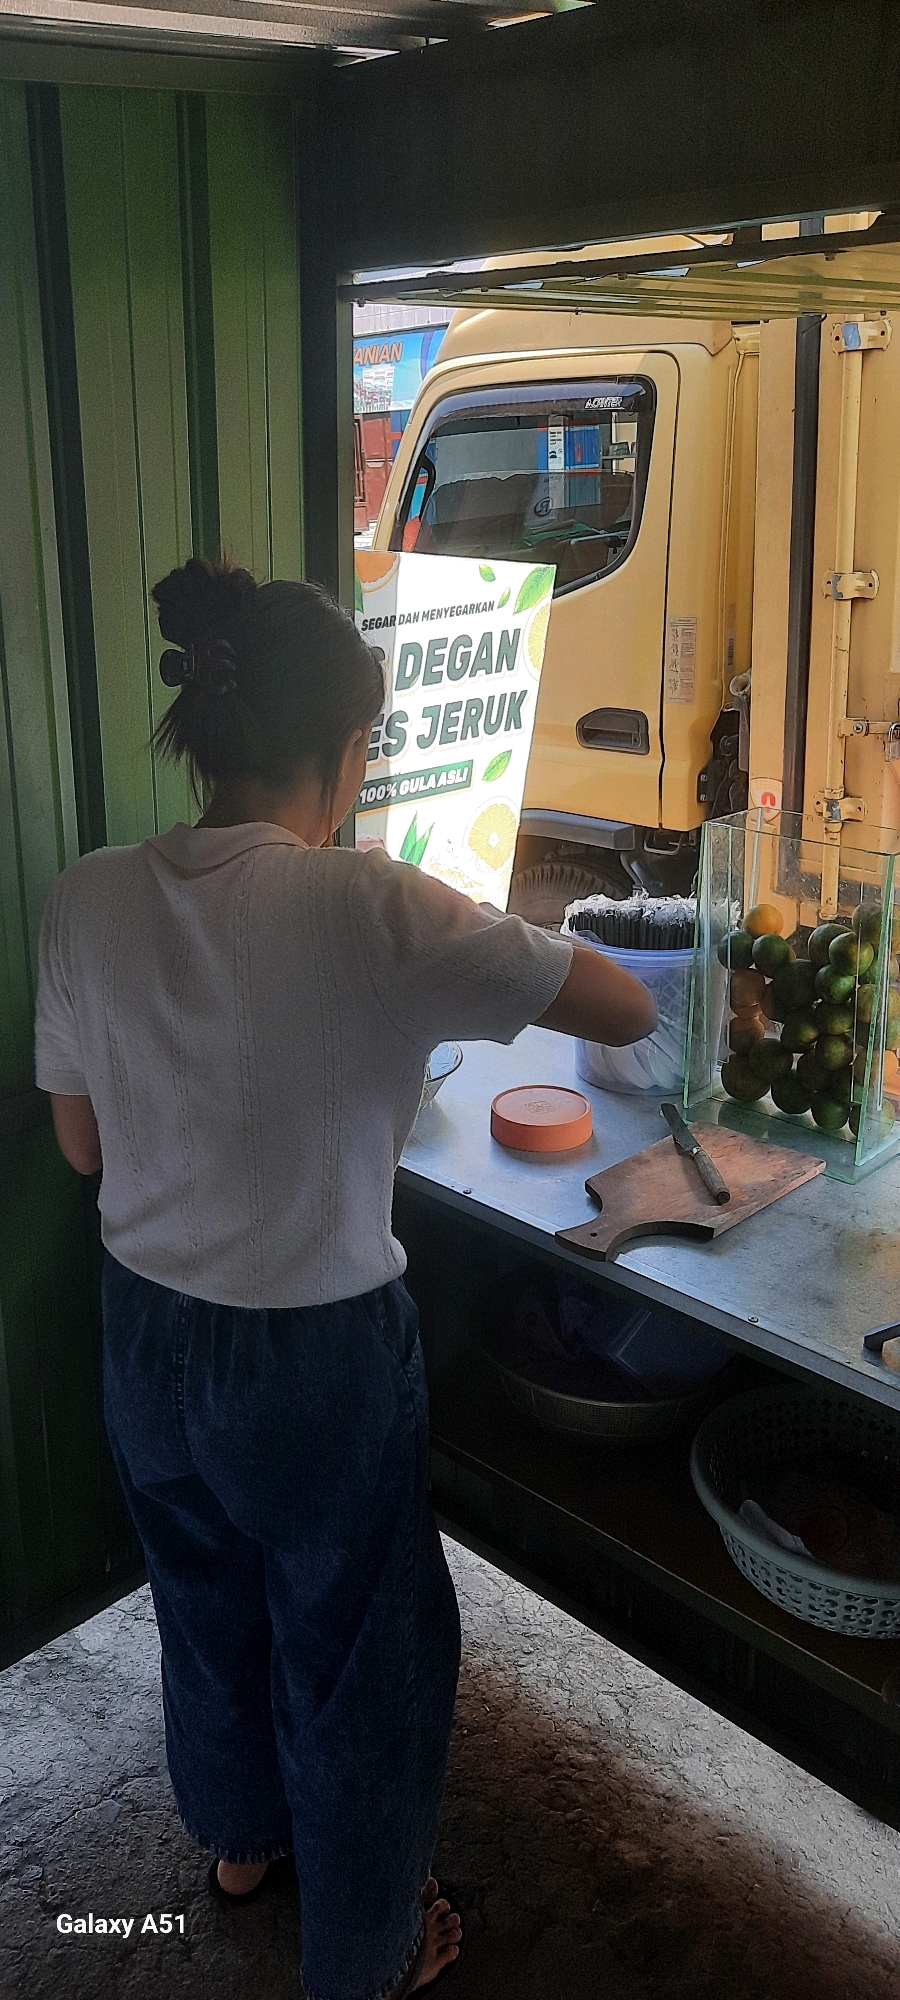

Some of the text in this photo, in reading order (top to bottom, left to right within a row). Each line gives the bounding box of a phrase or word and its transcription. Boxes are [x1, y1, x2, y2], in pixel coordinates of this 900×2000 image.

[361, 600, 495, 631] SEGAR DAN MENYEGARKAN
[395, 629, 522, 691] DEGAN
[416, 690, 528, 749] JERUK
[360, 766, 469, 805] 100% GULA ASLI
